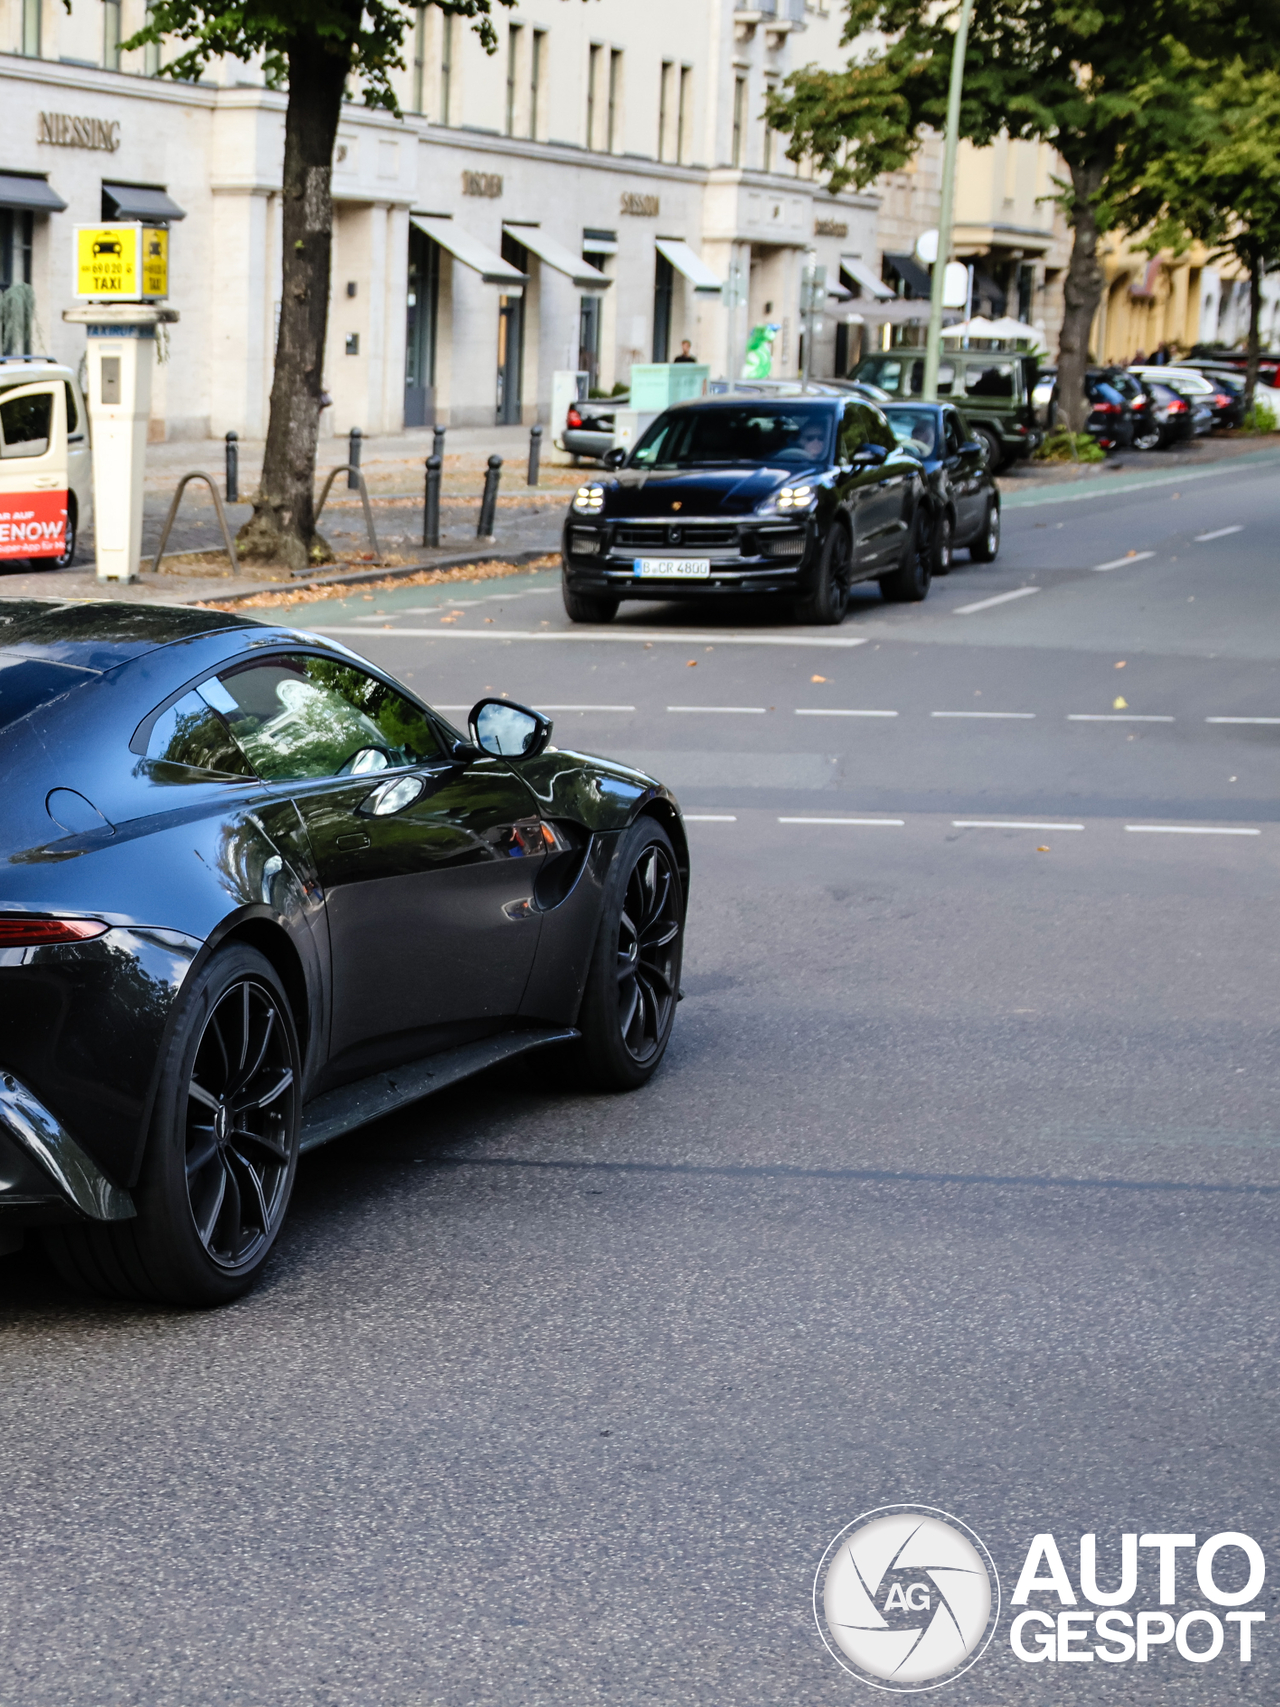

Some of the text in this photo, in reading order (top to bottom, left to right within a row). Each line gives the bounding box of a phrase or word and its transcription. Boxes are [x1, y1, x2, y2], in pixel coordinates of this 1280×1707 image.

[37, 111, 120, 152] NIESSING
[93, 277, 122, 290] TAXI
[12, 511, 35, 520] AUF
[41, 540, 53, 550] für
[643, 562, 708, 574] B CR 4800
